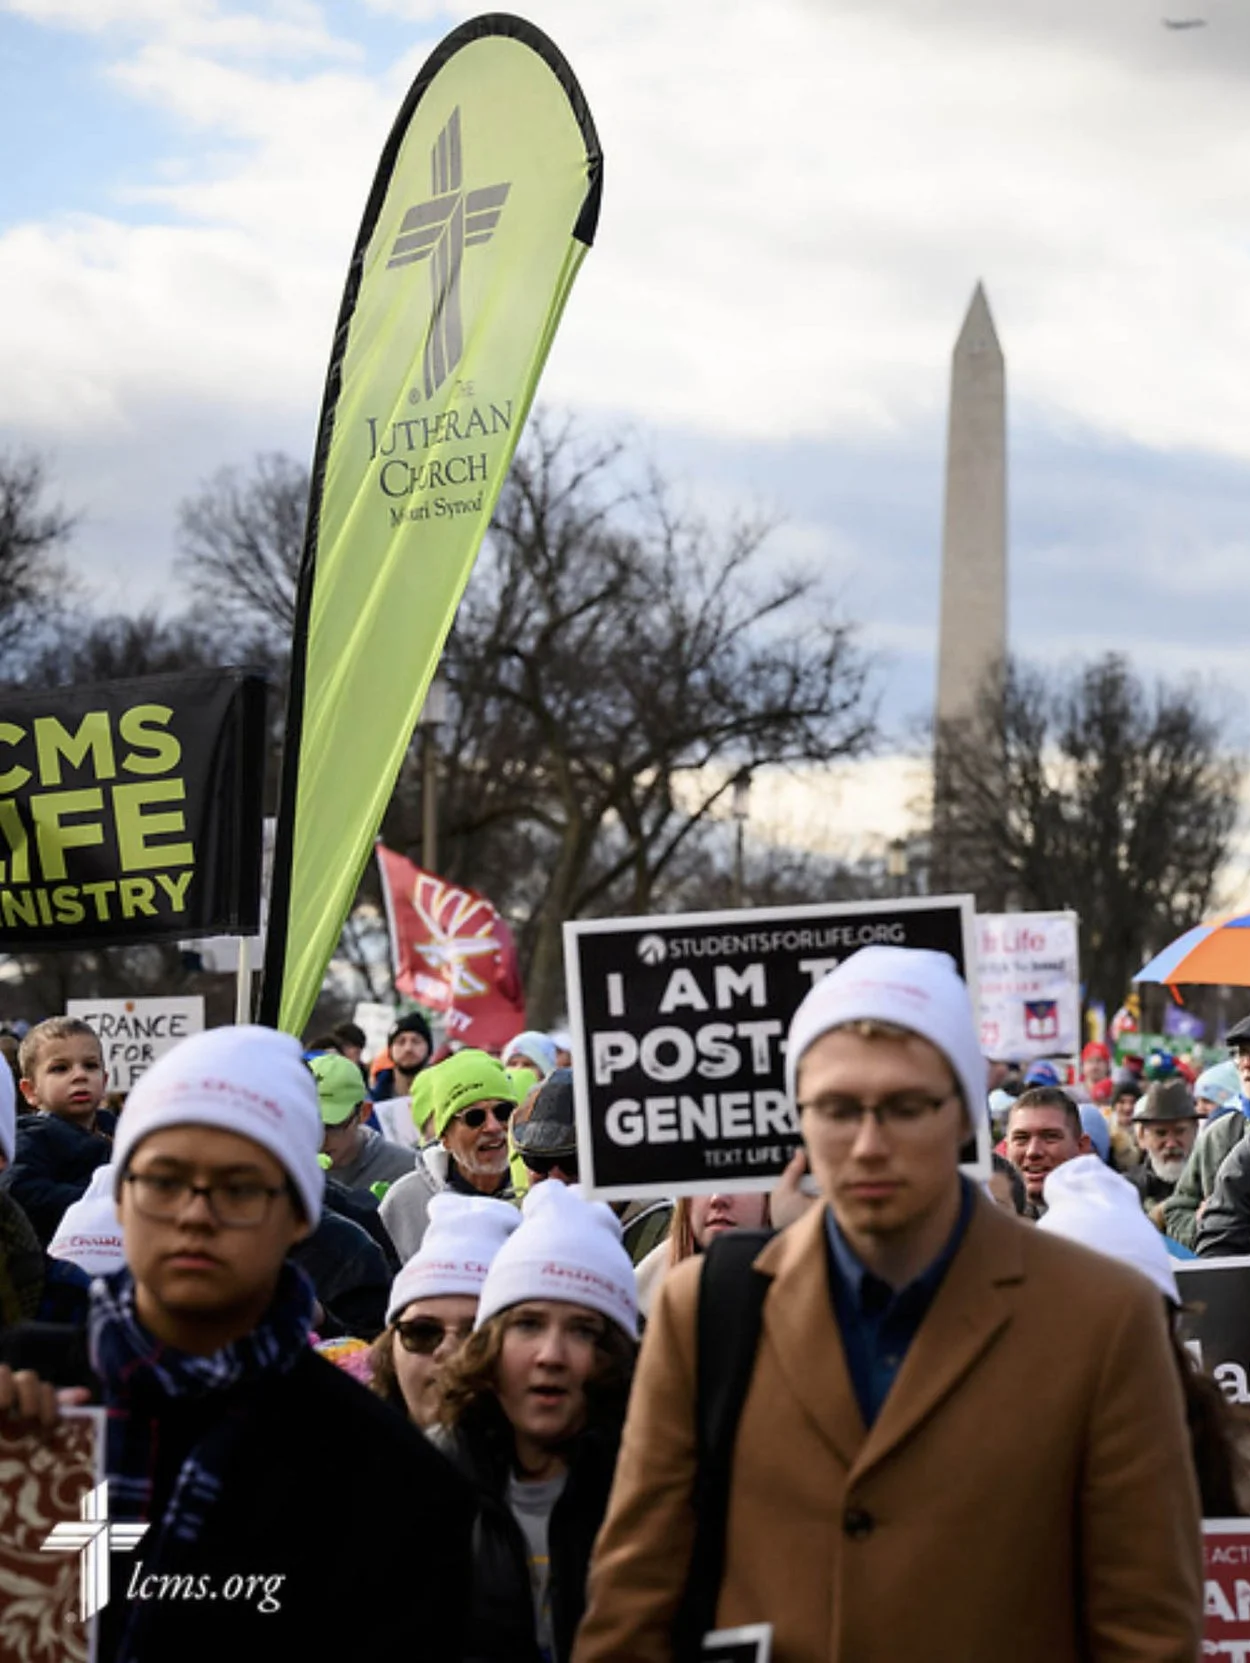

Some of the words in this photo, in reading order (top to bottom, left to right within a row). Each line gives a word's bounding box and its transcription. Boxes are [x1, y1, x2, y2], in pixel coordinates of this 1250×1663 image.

[0, 778, 195, 884] IFE
[0, 871, 194, 928] NISTRY
[669, 923, 906, 959] STUDENTSFORLIFE.ORG
[606, 972, 625, 1017] I
[658, 963, 767, 1014] AM
[109, 1042, 155, 1061] FOR
[605, 1089, 801, 1146] GENER
[704, 1149, 742, 1167] TEXT
[748, 1146, 782, 1164] LIFE
